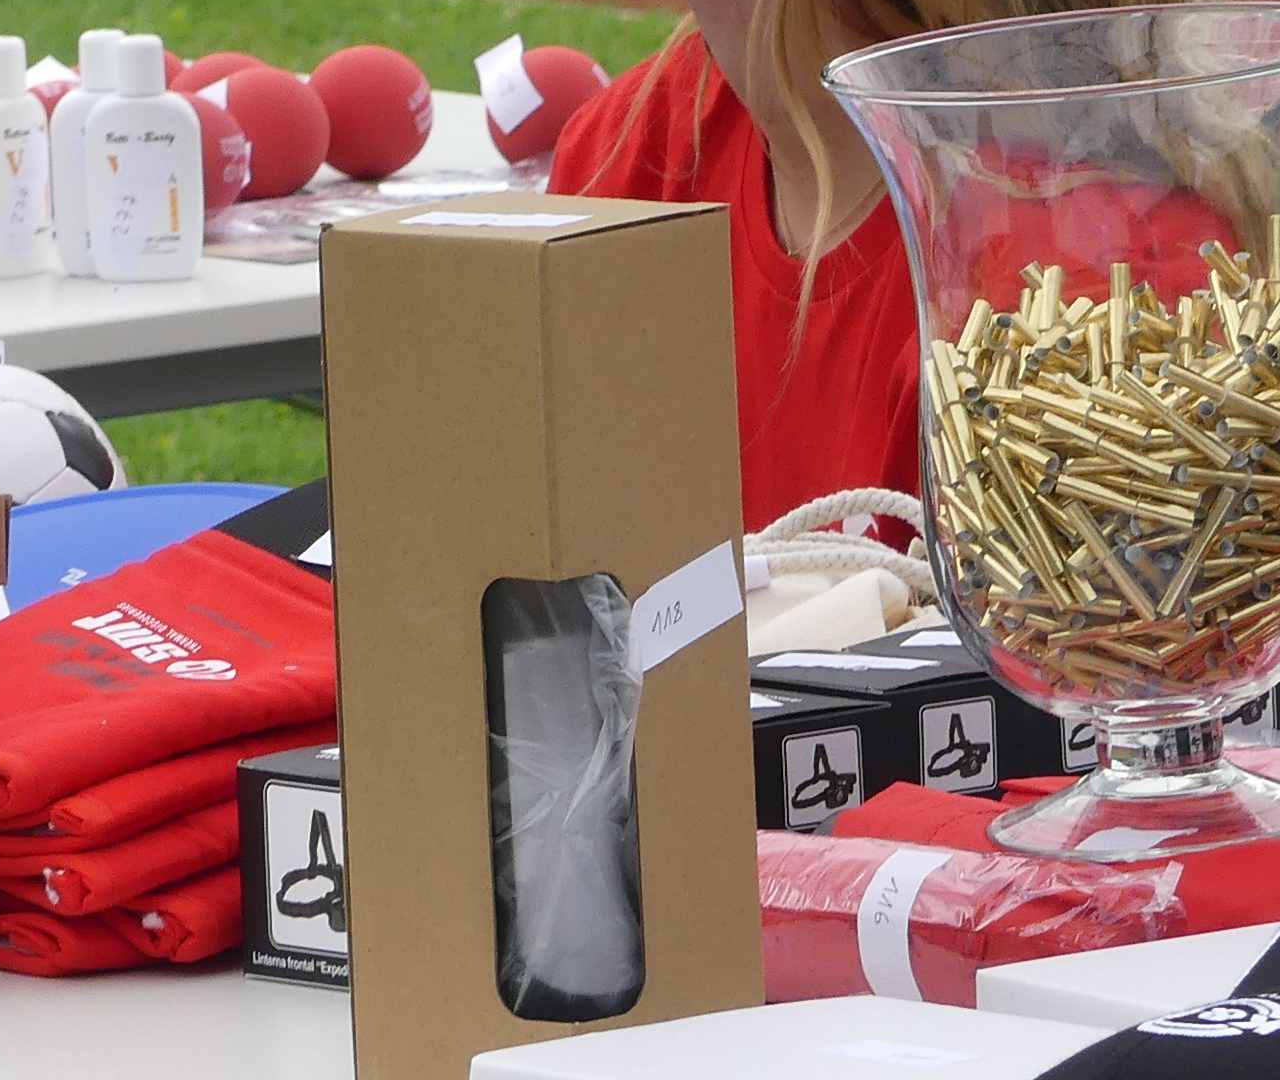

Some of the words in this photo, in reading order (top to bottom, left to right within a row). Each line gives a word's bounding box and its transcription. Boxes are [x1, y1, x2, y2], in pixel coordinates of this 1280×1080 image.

[166, 624, 203, 654] THERMAL
[252, 950, 287, 969] Linterna
[287, 955, 315, 972] frontal
